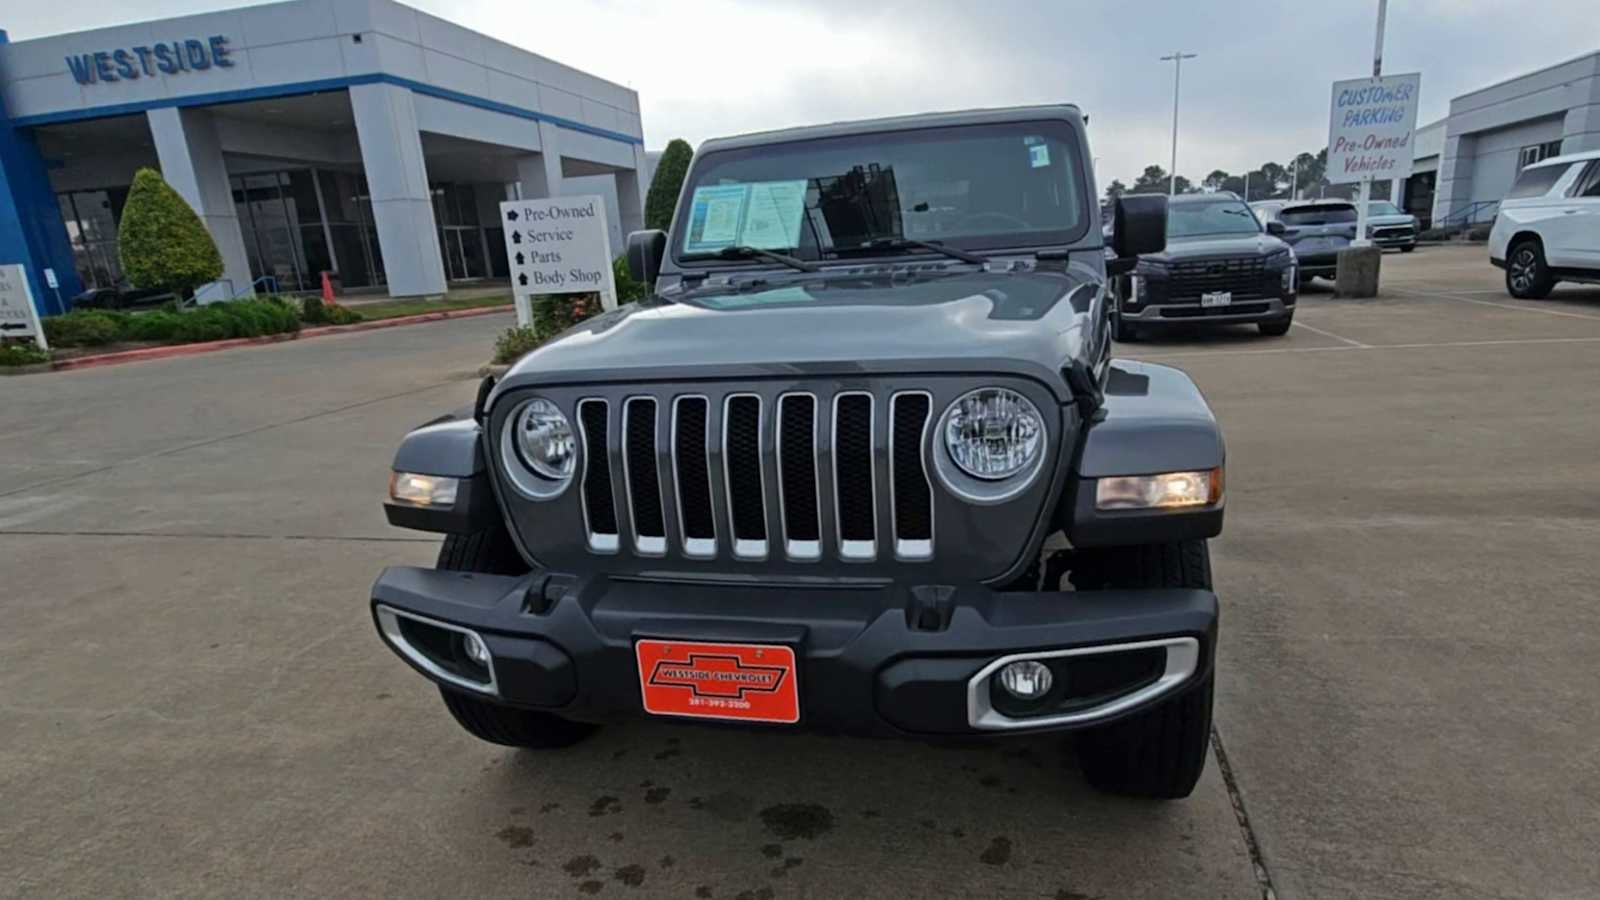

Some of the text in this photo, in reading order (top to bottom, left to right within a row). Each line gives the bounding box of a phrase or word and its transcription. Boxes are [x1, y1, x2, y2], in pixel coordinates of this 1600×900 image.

[65, 36, 234, 86] WESTSIDE
[1343, 108, 1405, 128] PARKING
[1334, 132, 1410, 153] Pre-Owned
[1344, 156, 1395, 173] Vehicles
[524, 203, 594, 221] Pre-Owned
[528, 228, 573, 243] Service
[531, 250, 562, 264] Parts
[534, 269, 602, 286] Body Shop
[663, 669, 772, 683] WESTSIDE CHEVROLET
